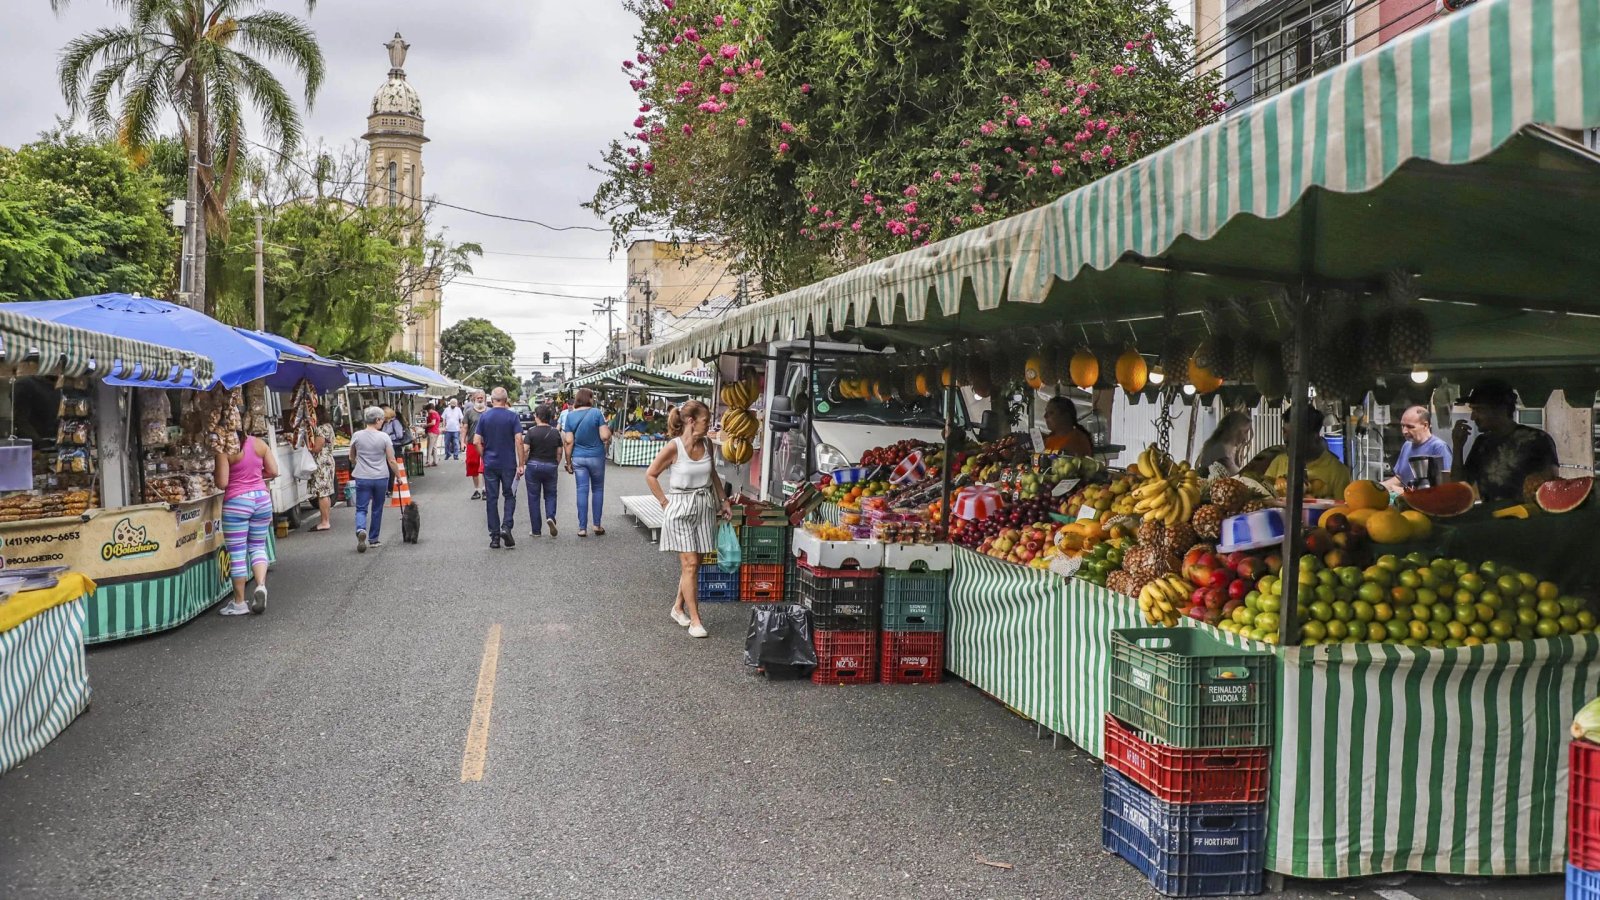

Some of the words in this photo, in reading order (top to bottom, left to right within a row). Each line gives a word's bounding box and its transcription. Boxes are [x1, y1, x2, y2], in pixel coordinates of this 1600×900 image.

[5, 537, 23, 547] (41)
[24, 531, 80, 545] 99940-6653
[7, 553, 64, 565] @BOLACHEIROO
[1208, 685, 1242, 694] REINALDO
[1212, 694, 1239, 702] LINDOIA
[1193, 837, 1203, 846] FF
